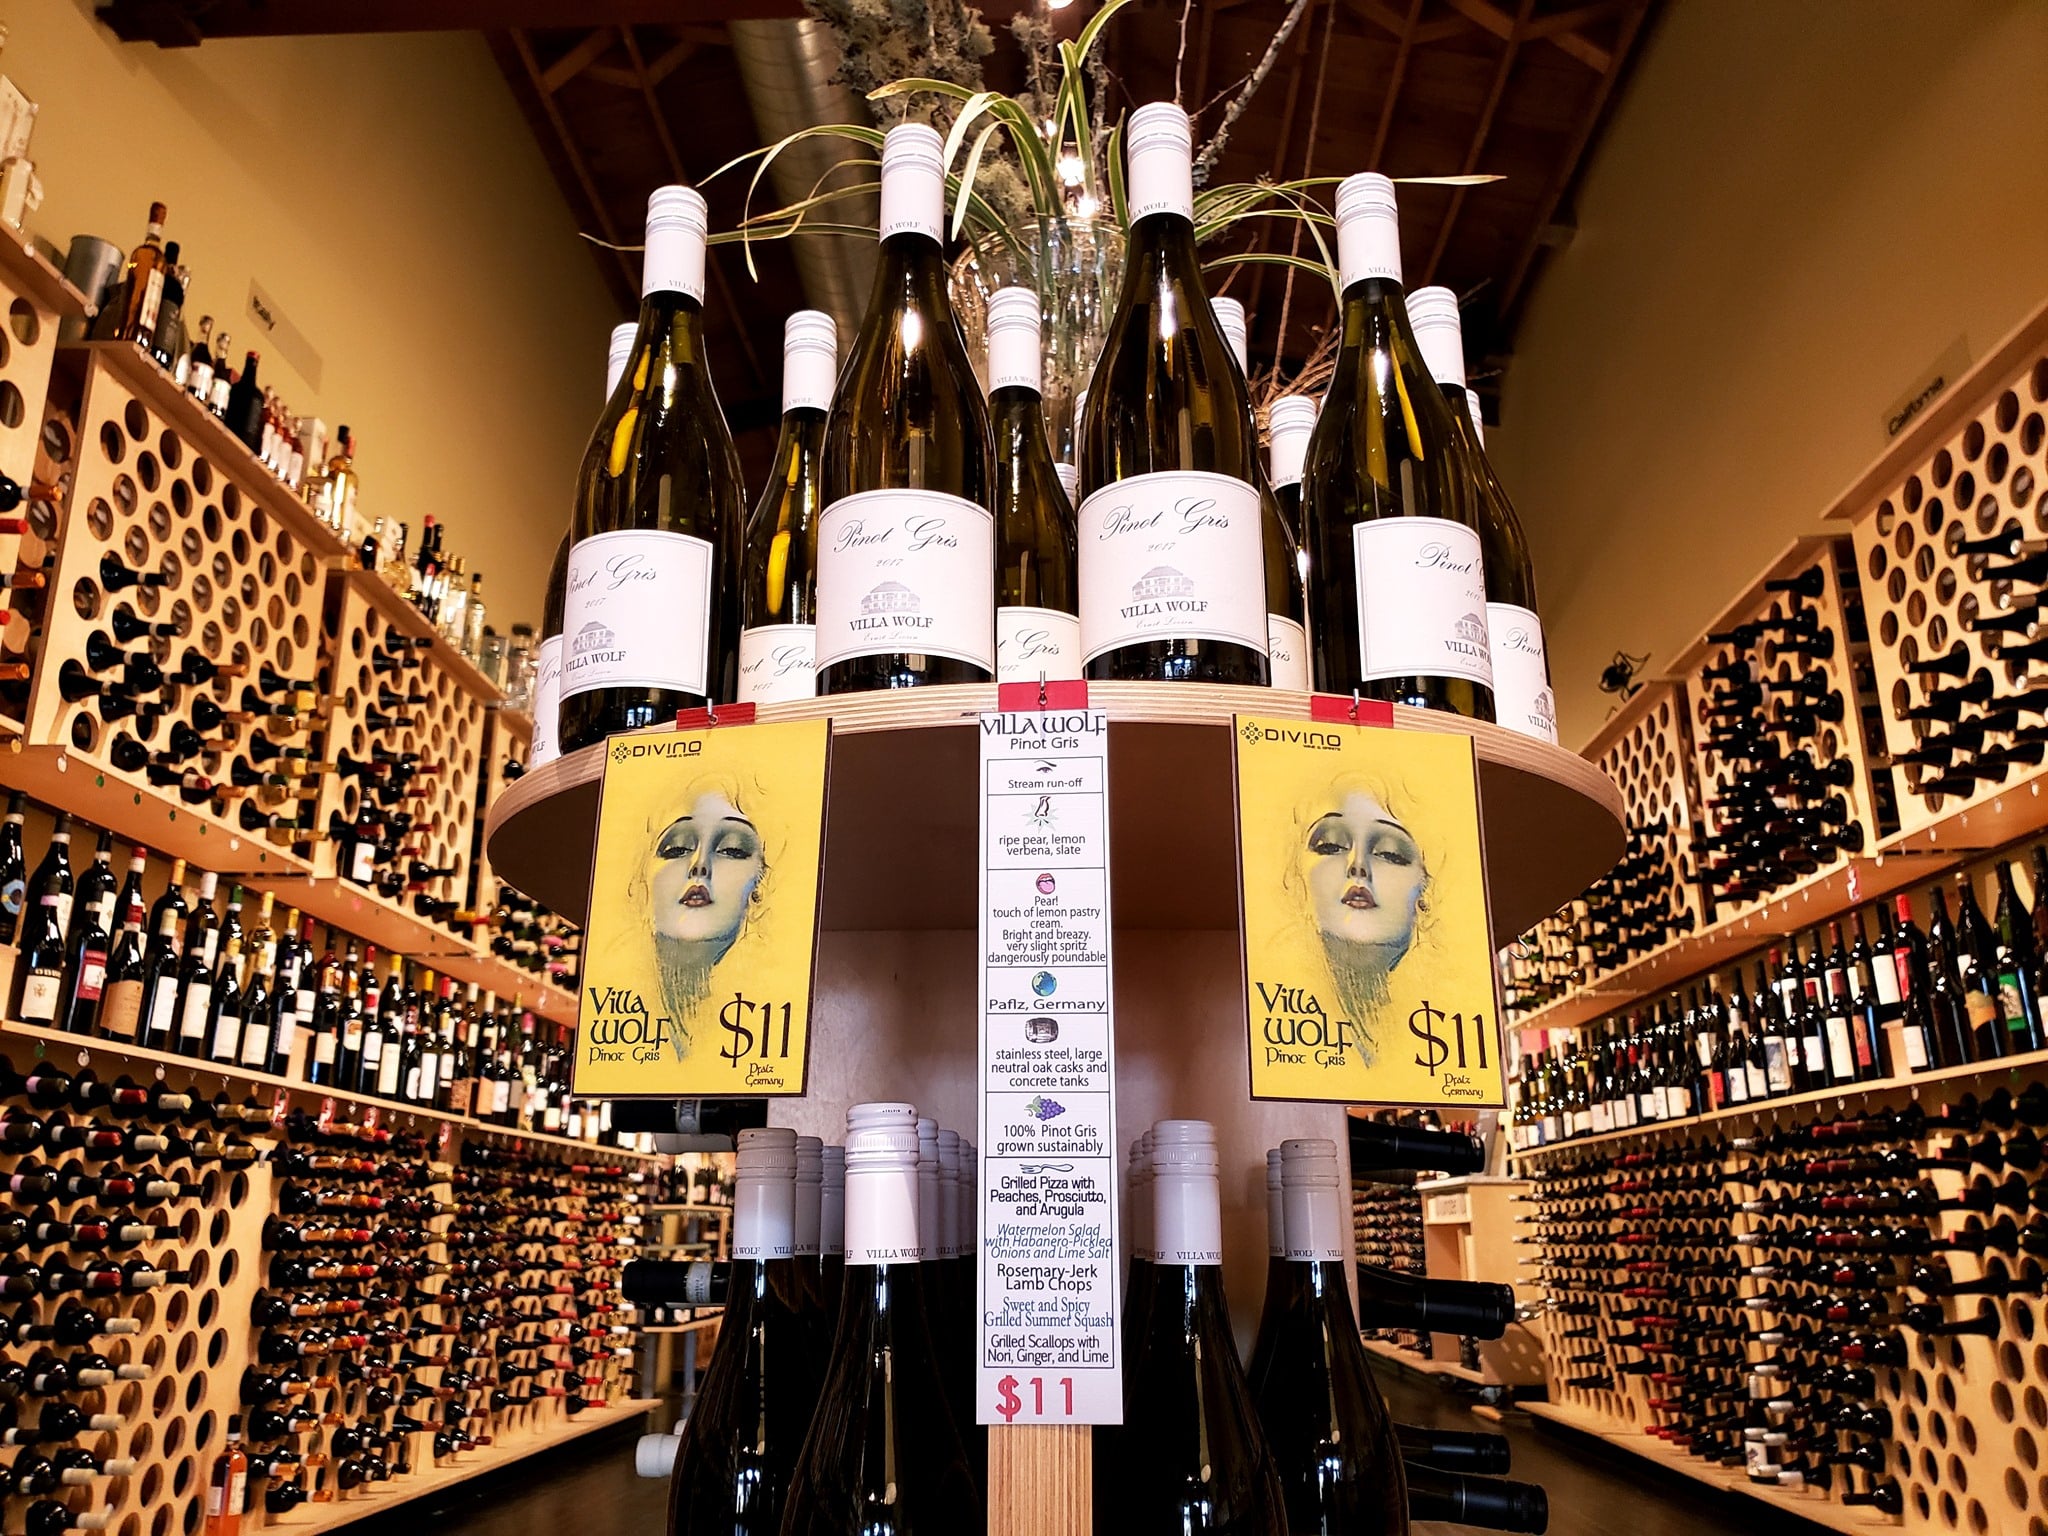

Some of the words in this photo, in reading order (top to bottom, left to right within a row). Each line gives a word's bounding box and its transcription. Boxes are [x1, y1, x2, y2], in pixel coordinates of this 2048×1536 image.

[1100, 505, 1163, 540] Pinot
[1174, 497, 1230, 534] Gris
[833, 518, 894, 553] Pinot
[904, 515, 958, 551] Gris
[1147, 542, 1176, 552] 2017
[876, 558, 904, 567] 2017
[1415, 542, 1472, 575] Pinot
[606, 554, 657, 590] Gris
[1120, 602, 1162, 618] VILLA
[1166, 600, 1208, 612] WOLF
[849, 616, 888, 631] VILLA
[892, 616, 934, 628] WOLF
[1015, 628, 1060, 659] Gris
[1444, 640, 1477, 657] VILLA
[591, 651, 626, 663] WOLF
[980, 714, 1038, 735] VILLA
[1043, 711, 1106, 736] WOLF
[1010, 737, 1046, 750] Pinot
[1051, 736, 1079, 749] Gris
[1265, 729, 1341, 747] DIVINO
[633, 741, 702, 757] DIVINO
[1008, 779, 1044, 789] Stream
[1047, 778, 1083, 788] run-off
[1000, 835, 1021, 847] ripe
[1023, 836, 1049, 848] pear,
[1051, 834, 1086, 844] lemon
[1007, 845, 1053, 857] verbena,
[1056, 845, 1081, 855] slate
[1035, 896, 1058, 906] Pear!
[993, 907, 1021, 917] touch
[1024, 907, 1034, 917] of
[1036, 907, 1067, 917] lemon
[1070, 907, 1100, 919] pastry
[1030, 919, 1063, 929] cream.
[1002, 930, 1032, 942] Bright
[1035, 930, 1054, 940] and
[1056, 929, 1091, 941] breazy.
[1007, 942, 1028, 953] very
[1030, 940, 1057, 952] slight
[1060, 941, 1087, 952] spritz
[988, 952, 1049, 965] dangerously
[1052, 951, 1106, 964] poundable
[589, 987, 646, 1014] Villa
[989, 999, 1029, 1011] Paflz,
[1033, 999, 1105, 1011] Germany
[1255, 982, 1325, 1014] Villa
[590, 1010, 672, 1050] WOLF
[719, 992, 791, 1068] $11
[1264, 1010, 1353, 1051] WOLF
[1408, 1000, 1488, 1076] $11
[589, 1047, 625, 1065] Pinot
[996, 1048, 1041, 1060] stainless
[1044, 1048, 1071, 1061] steel,
[1075, 1048, 1102, 1062] large
[1266, 1047, 1306, 1067] Pinot
[749, 1063, 774, 1077] Pfalz
[991, 1062, 1030, 1073] neutral
[1032, 1062, 1052, 1073] oak
[1055, 1062, 1083, 1073] casks
[1086, 1061, 1107, 1073] and
[745, 1074, 784, 1088] Germany
[1010, 1076, 1057, 1087] concrete
[1060, 1076, 1089, 1086] tanks
[1444, 1073, 1471, 1086] Pfalz
[1442, 1085, 1484, 1099] Germany
[1004, 1125, 1035, 1137] 100%
[1041, 1125, 1071, 1137] Pinot
[1074, 1125, 1097, 1137] Gris
[997, 1141, 1034, 1155] grown
[1038, 1139, 1103, 1155] sustainably
[1001, 1176, 1036, 1189] Grilled
[1040, 1176, 1068, 1189] Pizza
[1071, 1176, 1095, 1189] with
[990, 1189, 1041, 1203] Peaches,
[1045, 1189, 1106, 1203] Prosciutto,
[1016, 1203, 1036, 1215] and
[1040, 1203, 1084, 1219] Arugula
[998, 1224, 1065, 1236] Watermelon
[1068, 1223, 1100, 1236] Salad
[985, 1236, 1009, 1247] with
[1012, 1235, 1112, 1251] Habanero-Pickled
[739, 1246, 760, 1255] WOLF
[866, 1249, 898, 1259] VILLA
[991, 1247, 1031, 1258] Onions
[1033, 1247, 1055, 1258] and
[1058, 1247, 1085, 1258] Lime
[1088, 1246, 1110, 1259] Salt
[1157, 1251, 1166, 1260] LF
[1176, 1251, 1204, 1260] VILLA
[1293, 1249, 1315, 1257] WOLF
[1327, 1249, 1343, 1257] VILL
[997, 1264, 1098, 1281] Rosemary-Jerk
[1006, 1276, 1044, 1290] Lamb
[1049, 1277, 1092, 1294] Chops
[1003, 1296, 1035, 1312] Sweet
[1038, 1297, 1058, 1312] and
[1061, 1297, 1090, 1316] Spicy
[984, 1311, 1022, 1327] Grilled
[1025, 1312, 1072, 1327] Summer
[1074, 1312, 1113, 1332] Squash
[991, 1334, 1025, 1348] Grilled
[1028, 1335, 1075, 1351] Scallops
[1077, 1335, 1100, 1348] with
[988, 1349, 1014, 1364] Nori,
[1017, 1349, 1055, 1365] Ginger,
[1058, 1349, 1079, 1363] and
[1082, 1350, 1109, 1363] Lime
